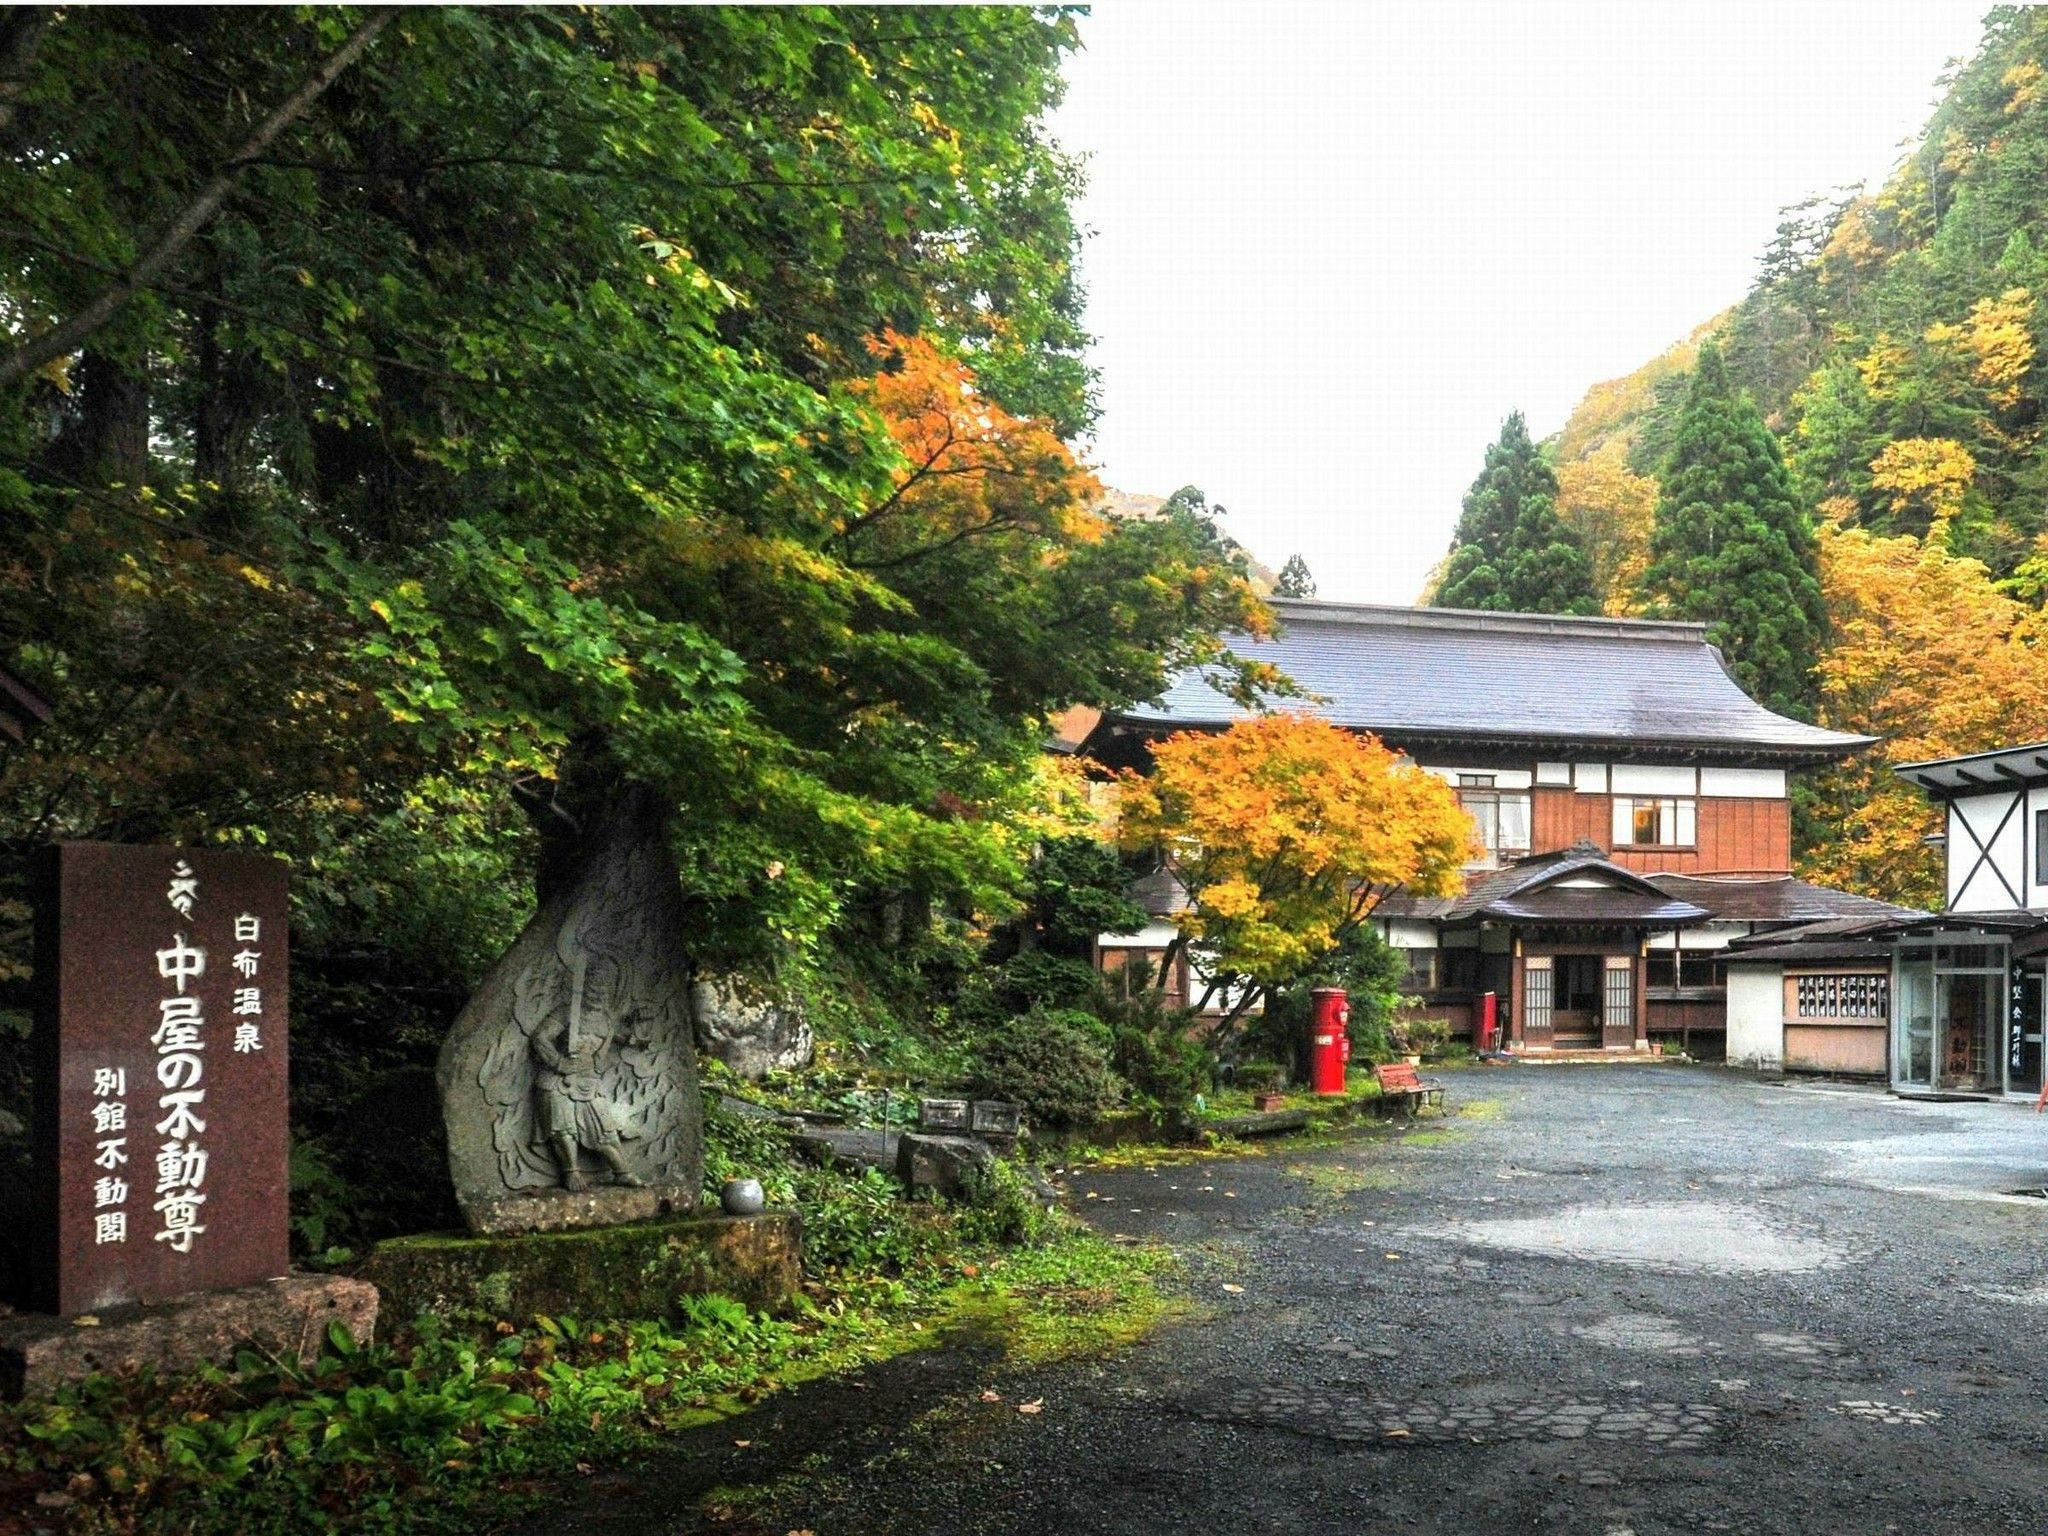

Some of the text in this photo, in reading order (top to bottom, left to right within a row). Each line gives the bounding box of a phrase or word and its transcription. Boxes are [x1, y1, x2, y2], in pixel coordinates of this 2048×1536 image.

[232, 911, 263, 1054] 白布温泉
[91, 1067, 129, 1245] 別館不動閣
[150, 932, 209, 1254] 中屋の不動尊
